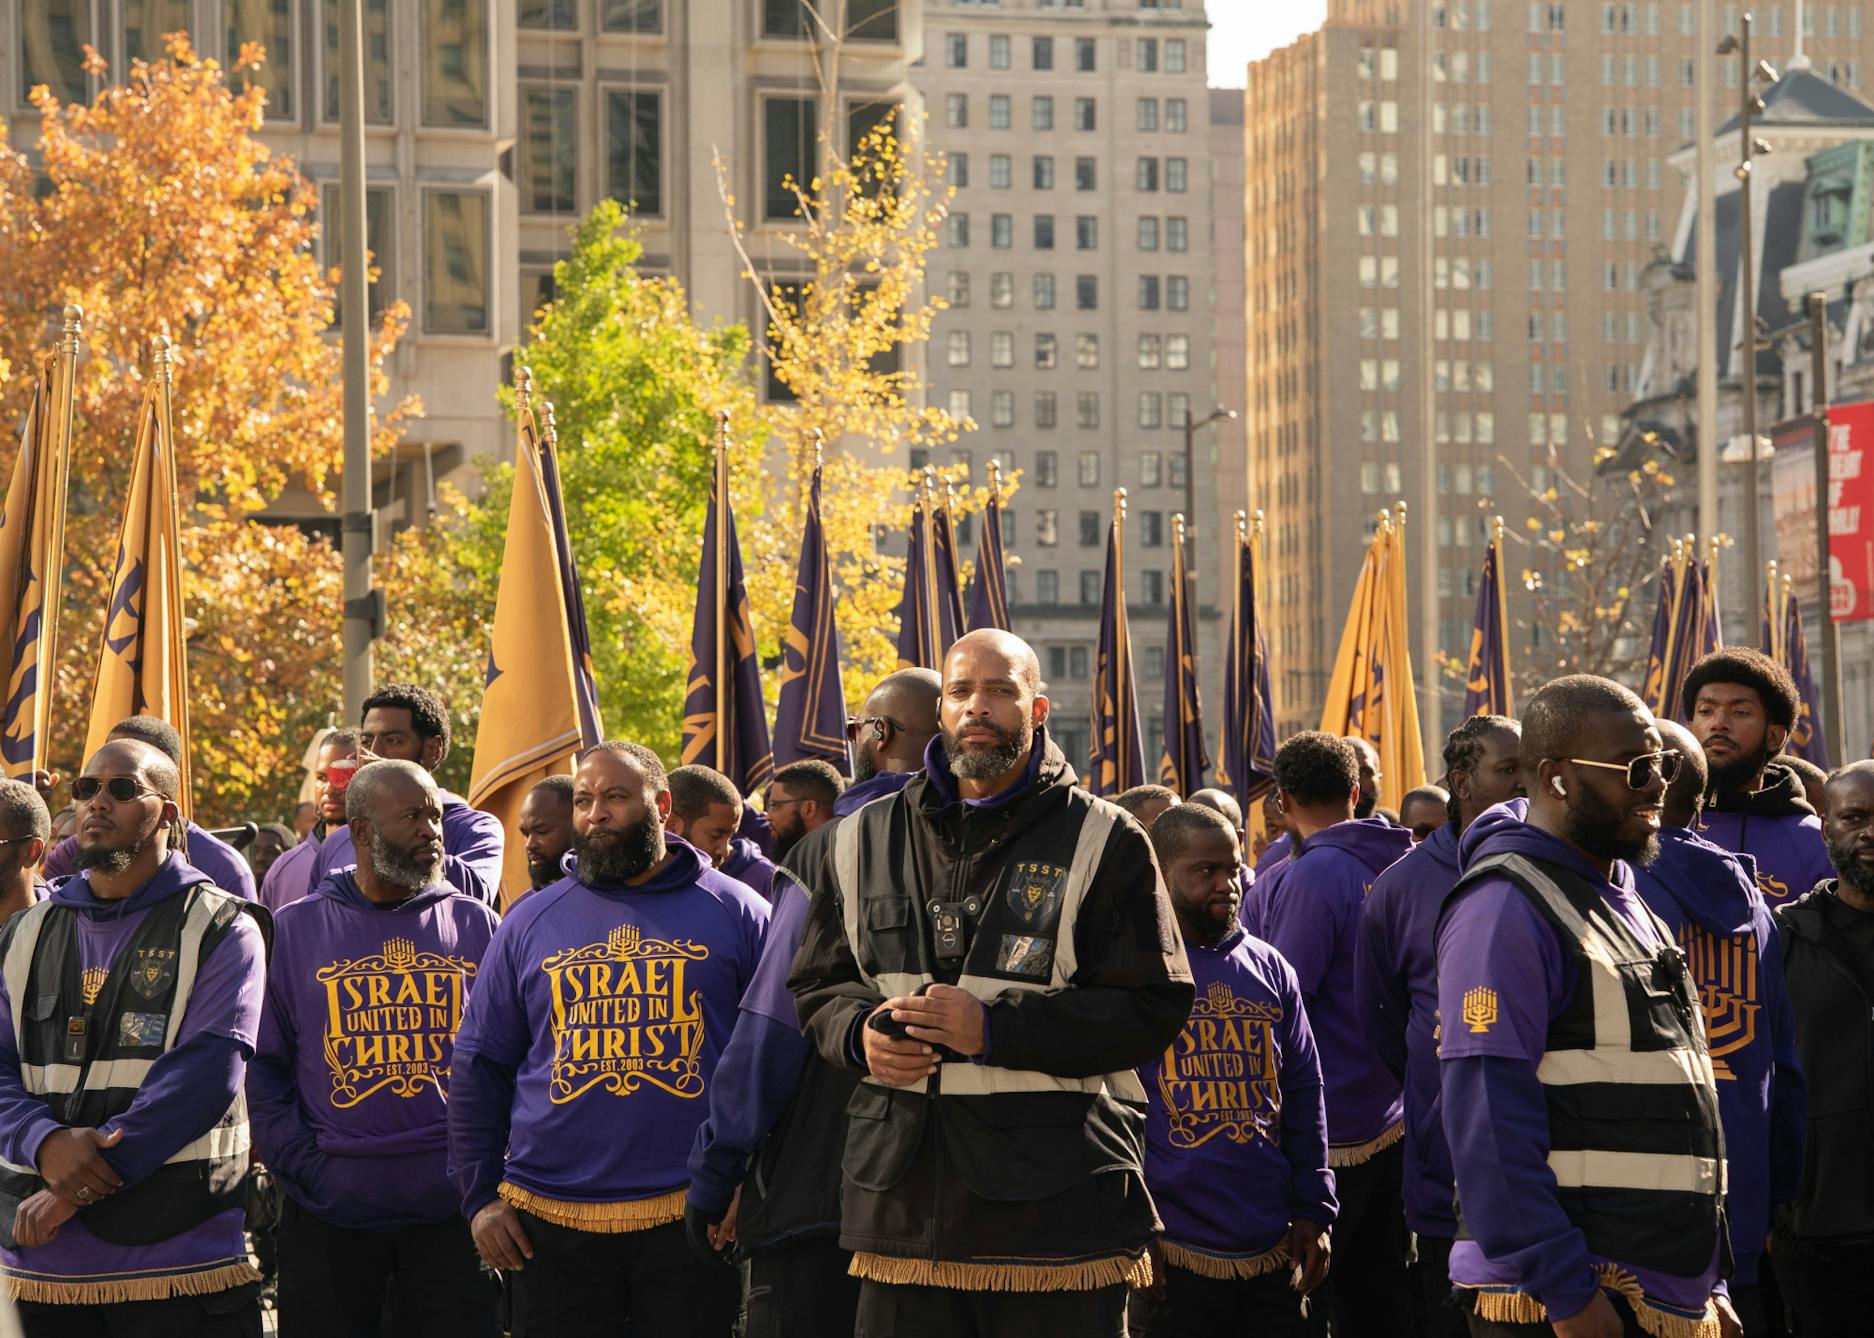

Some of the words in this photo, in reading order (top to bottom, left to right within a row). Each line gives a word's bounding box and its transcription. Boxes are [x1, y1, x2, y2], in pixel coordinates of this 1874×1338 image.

[1017, 863, 1062, 877] TSST
[548, 959, 699, 1030] ISRAEL
[346, 1006, 422, 1032] UNITED
[429, 1008, 447, 1029] IN
[569, 998, 640, 1024] UNITED
[648, 998, 668, 1021] IN
[331, 1033, 456, 1069] CHRIS
[557, 1021, 698, 1061] CHRIST
[386, 1062, 429, 1076] EST.2003
[601, 1058, 644, 1072] EST.2003
[1181, 1053, 1244, 1077] UNITED
[1250, 1056, 1262, 1076] IN
